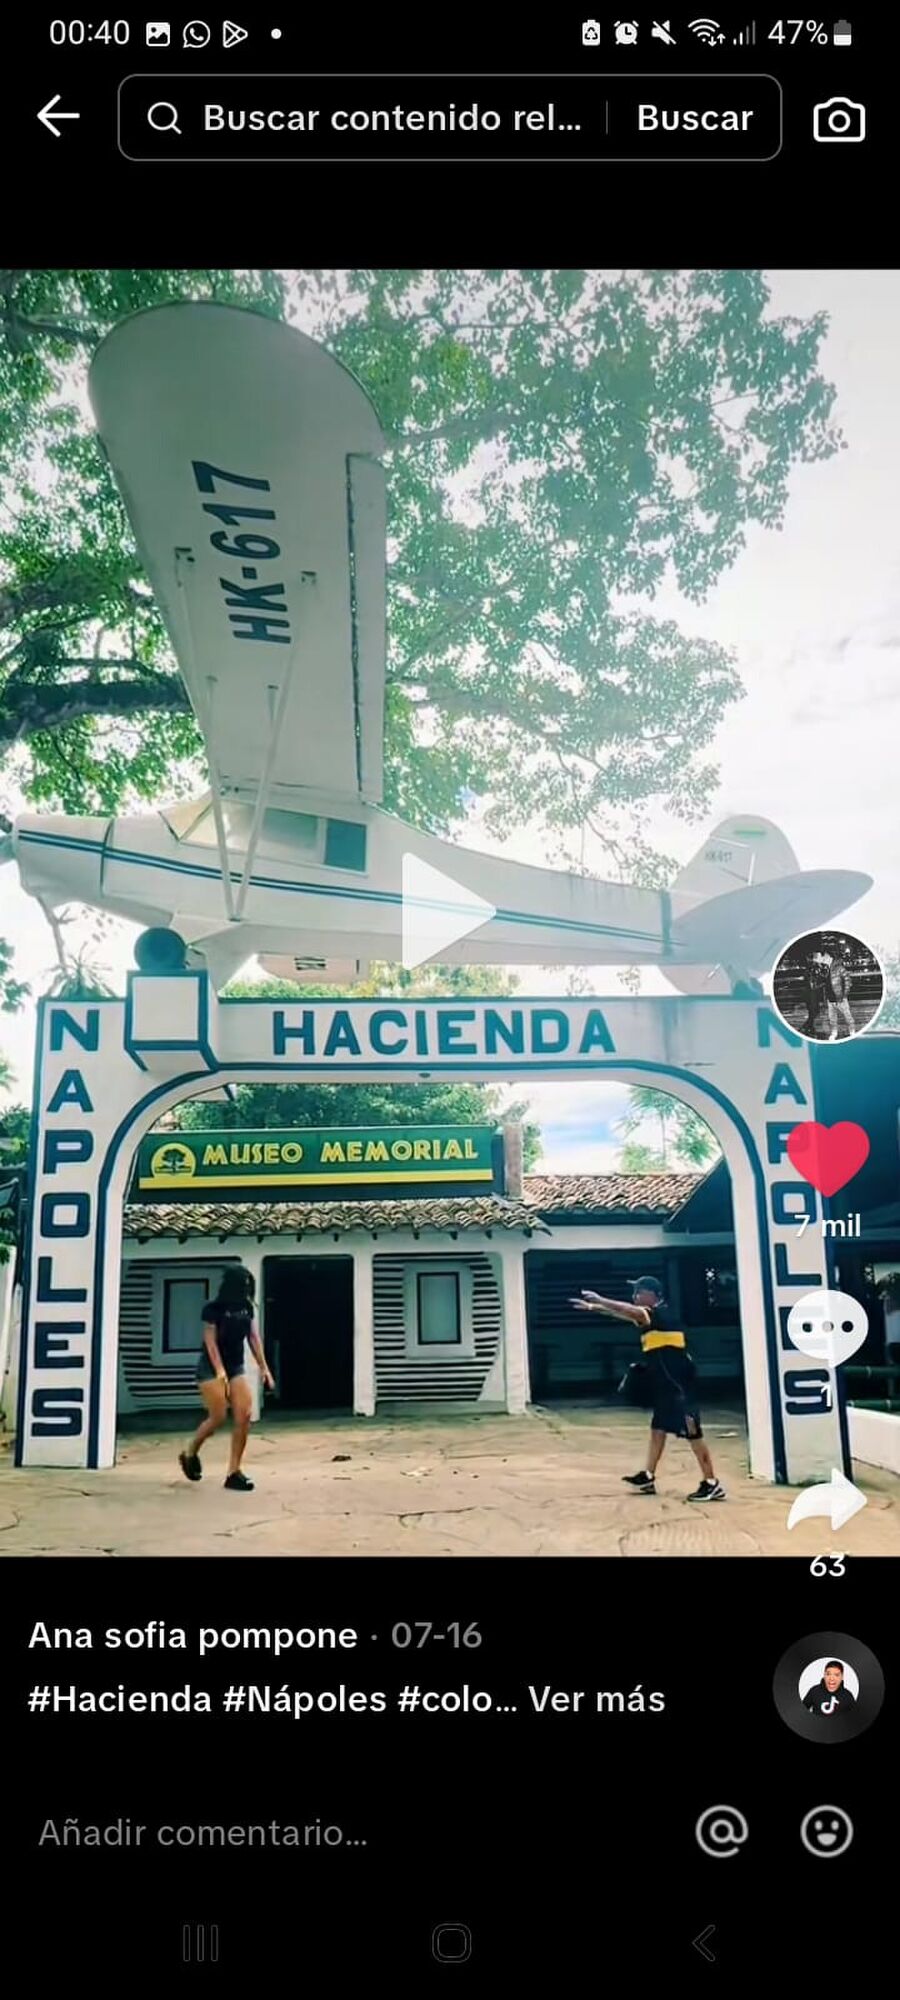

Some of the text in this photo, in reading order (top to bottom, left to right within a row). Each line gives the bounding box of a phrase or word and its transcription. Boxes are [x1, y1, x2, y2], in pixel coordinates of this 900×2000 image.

[191, 460, 291, 644] HK-617
[273, 1008, 616, 1056] HACIENDA
[202, 1138, 478, 1166] MUSEO MEMORIAL
[31, 1009, 99, 1437] NAPOLES
